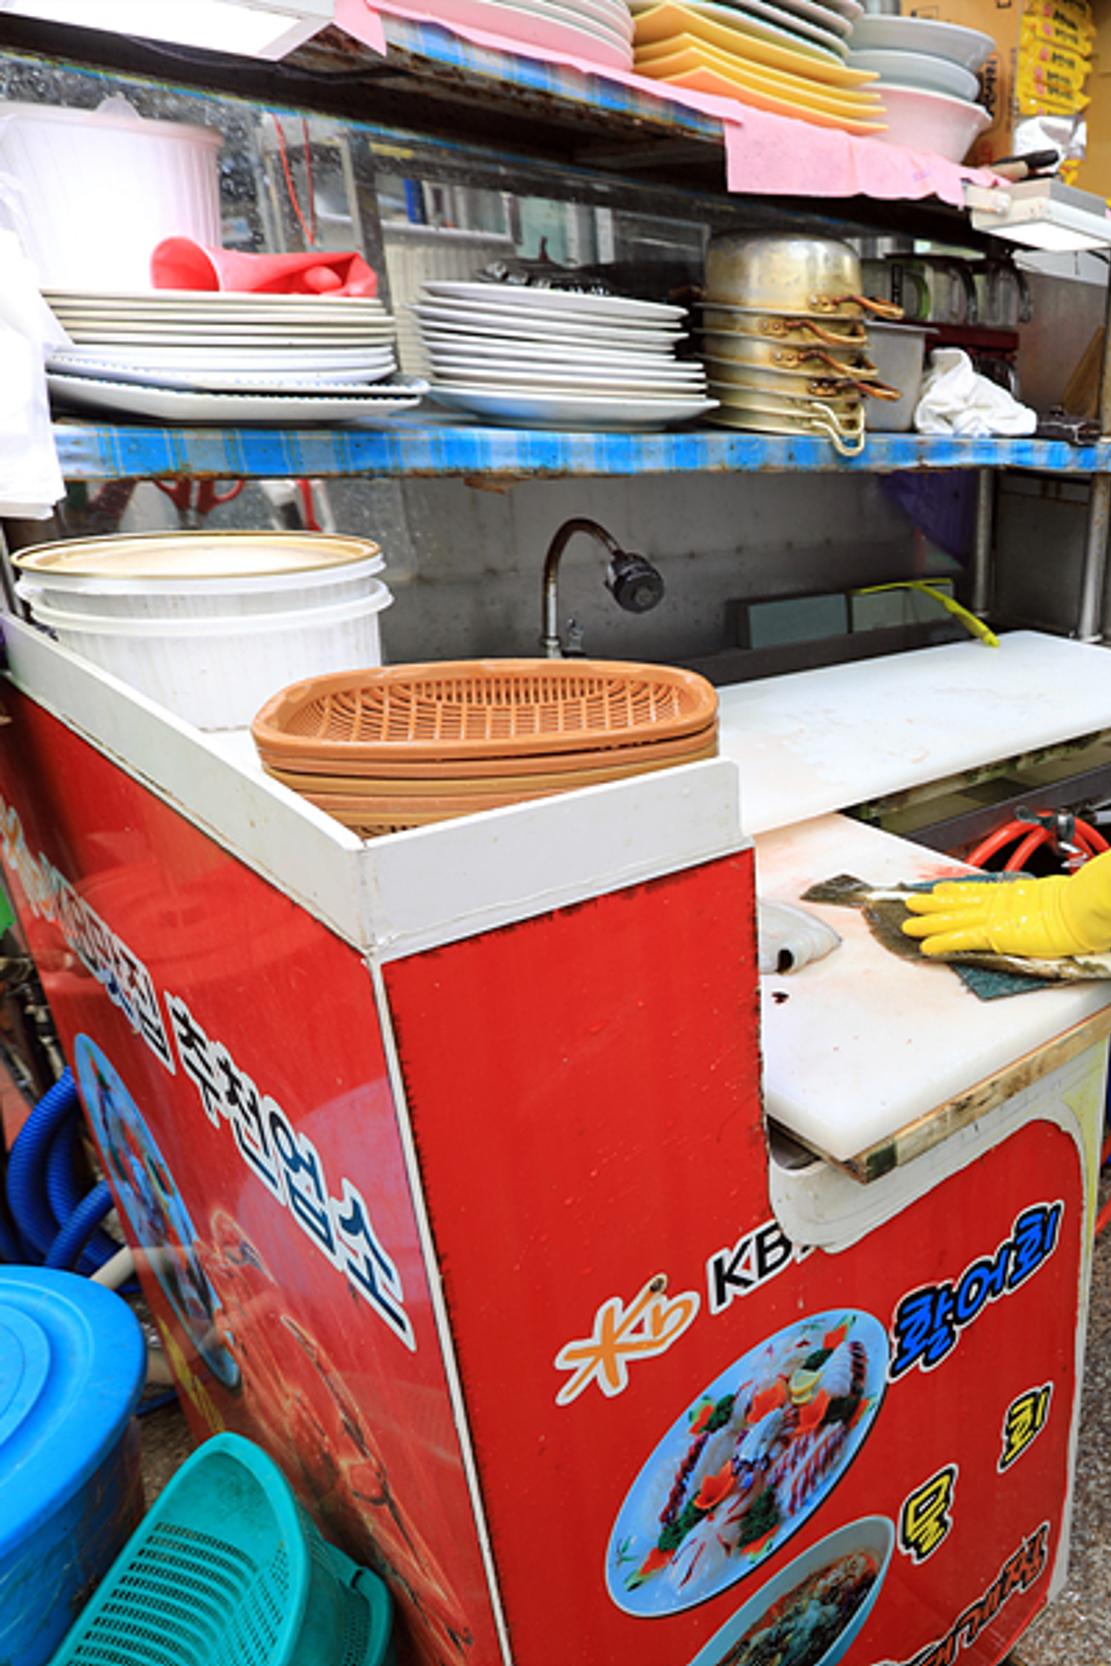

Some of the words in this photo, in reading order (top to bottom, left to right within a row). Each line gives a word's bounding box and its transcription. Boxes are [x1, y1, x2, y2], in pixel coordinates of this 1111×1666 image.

[166, 993, 414, 1348] 추천업소
[707, 1220, 813, 1313] KB
[888, 1202, 1063, 1380] 활어회
[899, 1464, 957, 1564] 물
[998, 1382, 1052, 1473] 회
